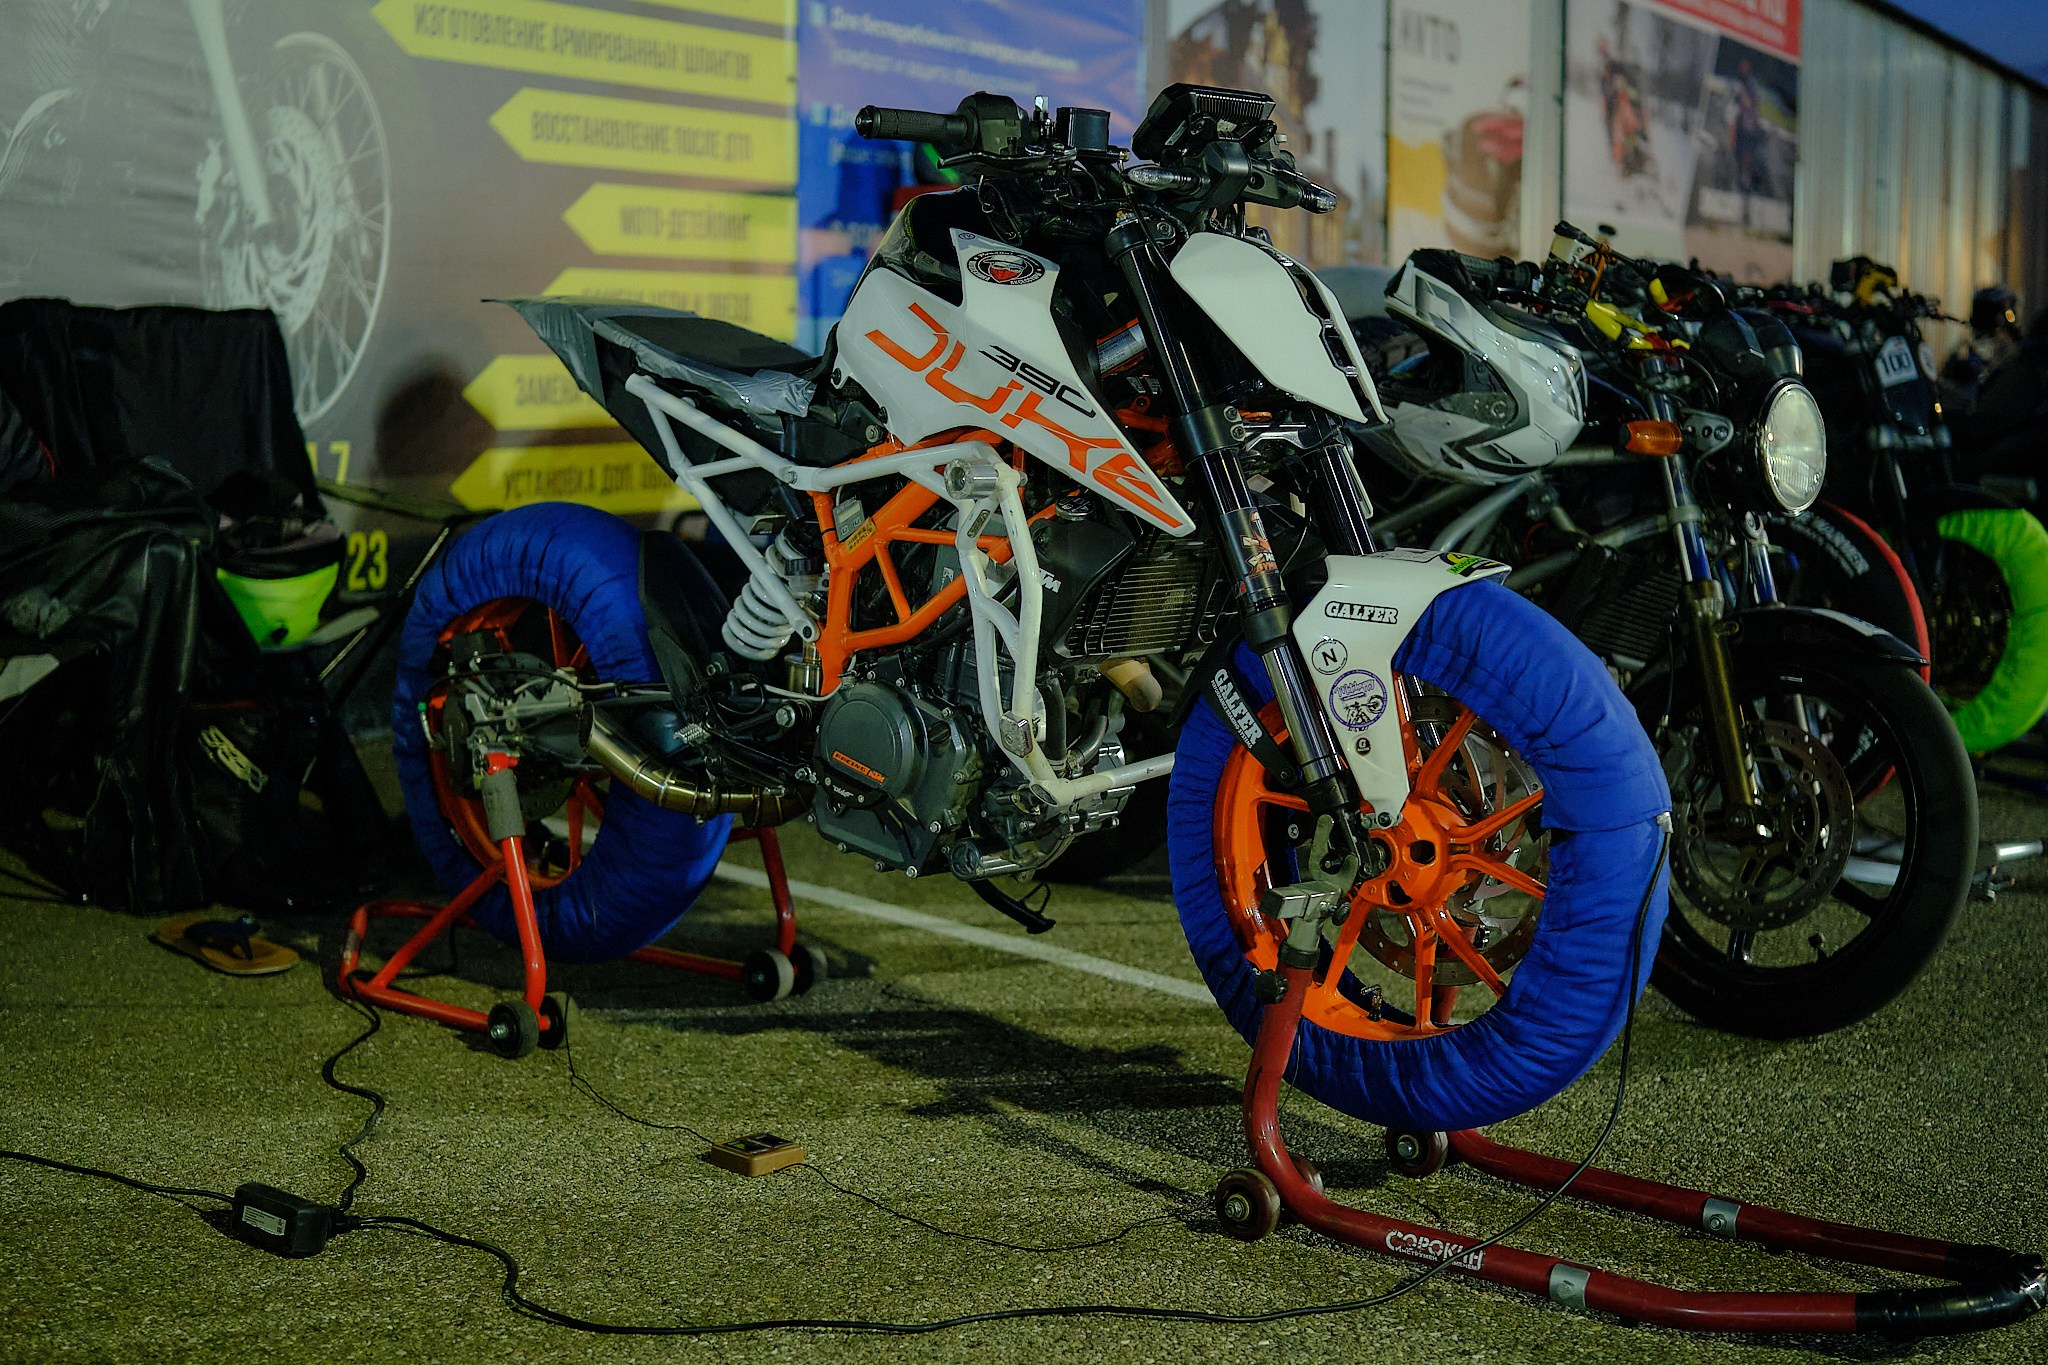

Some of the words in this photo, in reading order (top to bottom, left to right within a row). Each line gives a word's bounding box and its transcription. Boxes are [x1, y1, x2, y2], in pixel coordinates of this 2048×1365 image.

[415, 4, 546, 52] ИЗГОТОВЛЕНИЕ
[551, 24, 677, 70] АРМИРОВАННЫХ
[683, 42, 752, 80] ШЛАНГОВ
[531, 109, 671, 154] ВОССТАНОВЛЕНИЕ
[675, 126, 720, 159] ПОСЛЕ
[724, 132, 752, 161] ДТП
[620, 205, 751, 241] МОТО-ДЕТЕЙЛИНГ
[865, 302, 1183, 528] DUKE
[346, 529, 389, 592] 23
[1039, 567, 1062, 594] TM
[1326, 601, 1398, 624] GALFER
[1321, 648, 1338, 666] N
[1214, 668, 1263, 746] GALFER
[834, 752, 868, 773] RACING
